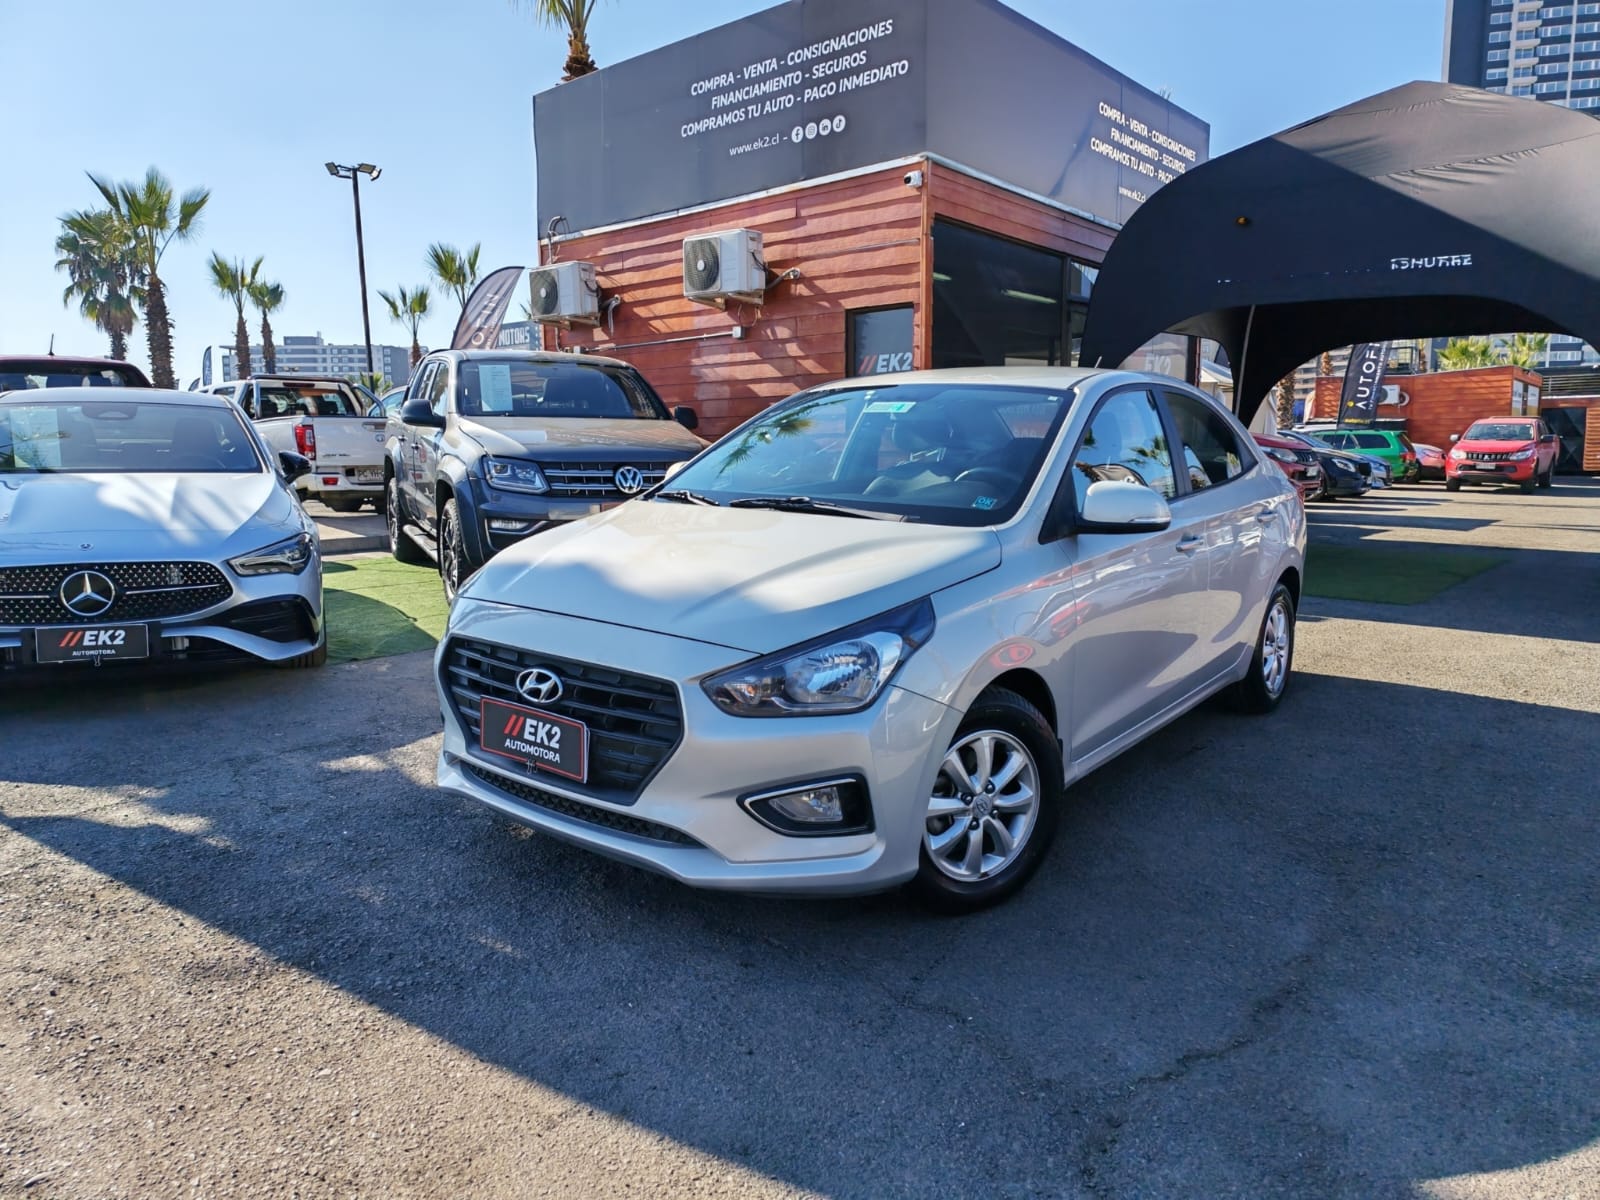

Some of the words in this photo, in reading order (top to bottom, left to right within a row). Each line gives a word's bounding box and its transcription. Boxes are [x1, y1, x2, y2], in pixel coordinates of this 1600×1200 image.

[691, 73, 735, 96] COMPRA
[743, 58, 778, 80] VENTA
[787, 19, 894, 67] CONSIGNACIONES
[711, 70, 802, 110] FINANCIAMIENTO
[812, 50, 867, 80] SEGUROS
[681, 108, 746, 138] COMPRAMOS
[747, 102, 761, 119] TU
[763, 94, 794, 116] AUTO
[804, 81, 837, 103] PAGO
[839, 59, 909, 94] INMEDIATO
[729, 133, 780, 156] www.ek2.cl
[1090, 137, 1130, 167] COMPRAMOS
[1130, 157, 1138, 171] TU
[1138, 160, 1154, 177] AUTO
[1099, 102, 1126, 127] COMPRA
[1129, 118, 1148, 139] VENTA
[1151, 130, 1197, 162] CONSIGNACIONES
[1110, 128, 1159, 161] FINANCIAMIENTO
[1162, 154, 1186, 174] SEGUROS
[1355, 342, 1380, 410] AUTOFI
[72, 648, 116, 657] AUTOMOTORA
[504, 738, 561, 763] AUTOMOTORA
